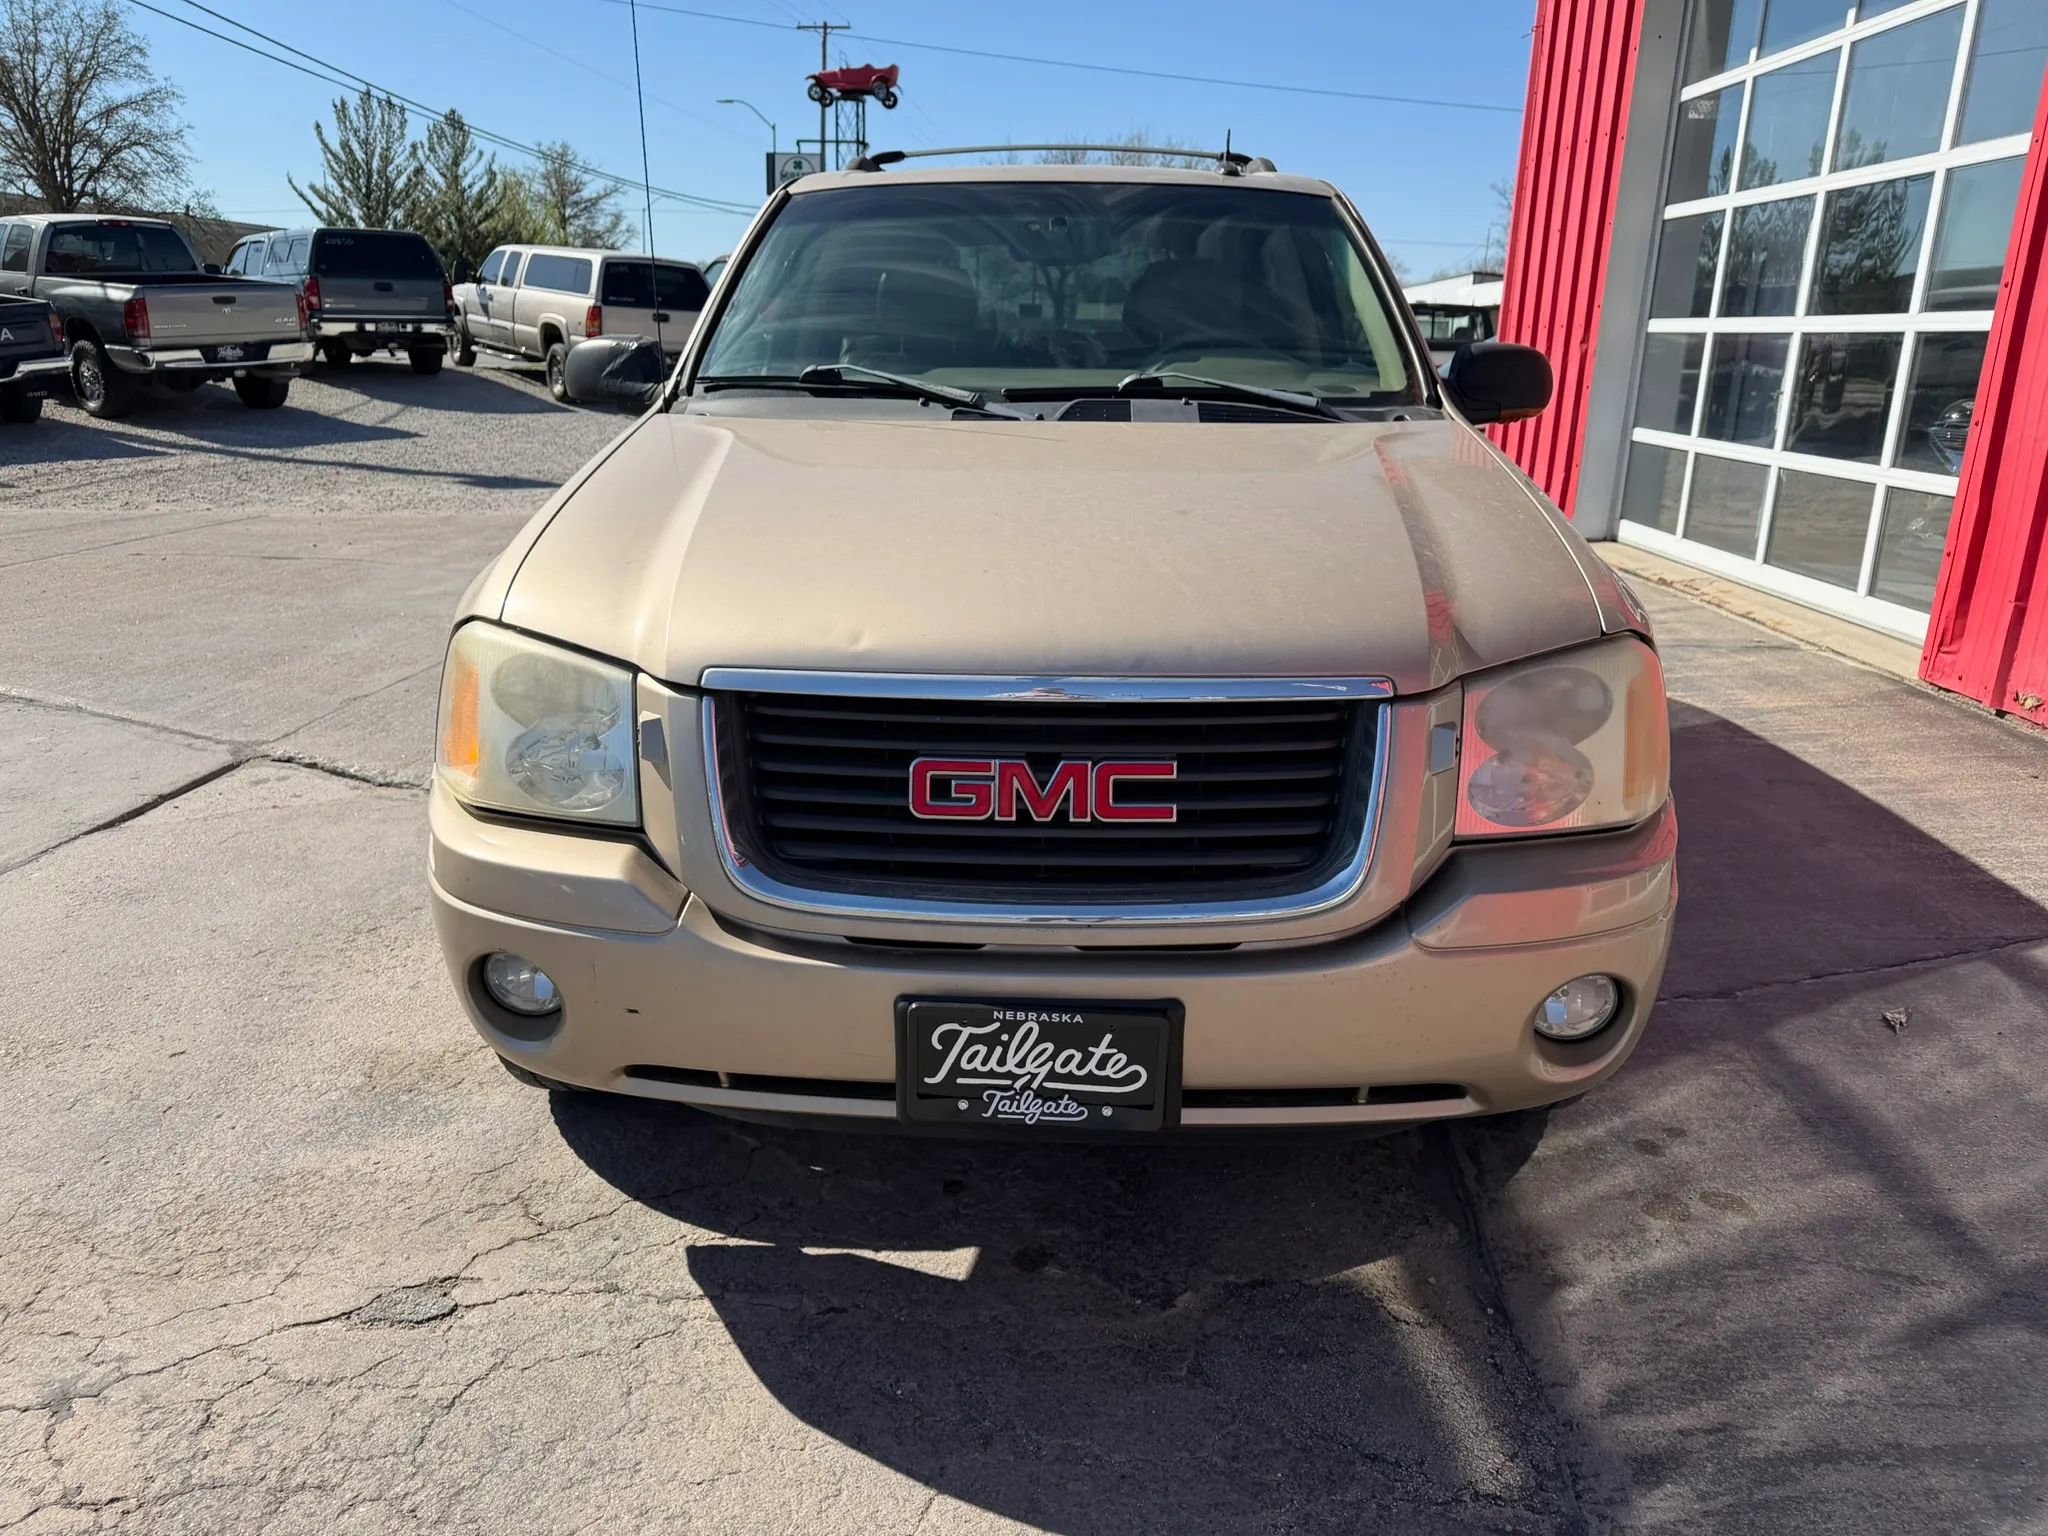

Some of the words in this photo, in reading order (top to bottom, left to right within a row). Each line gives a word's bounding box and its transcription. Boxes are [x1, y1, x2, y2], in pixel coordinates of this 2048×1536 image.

[908, 757, 1178, 822] GMC
[993, 1010, 1084, 1024] NEBRASKA
[923, 1020, 1148, 1093] Tailgate
[982, 1089, 1089, 1125] Tailgate
